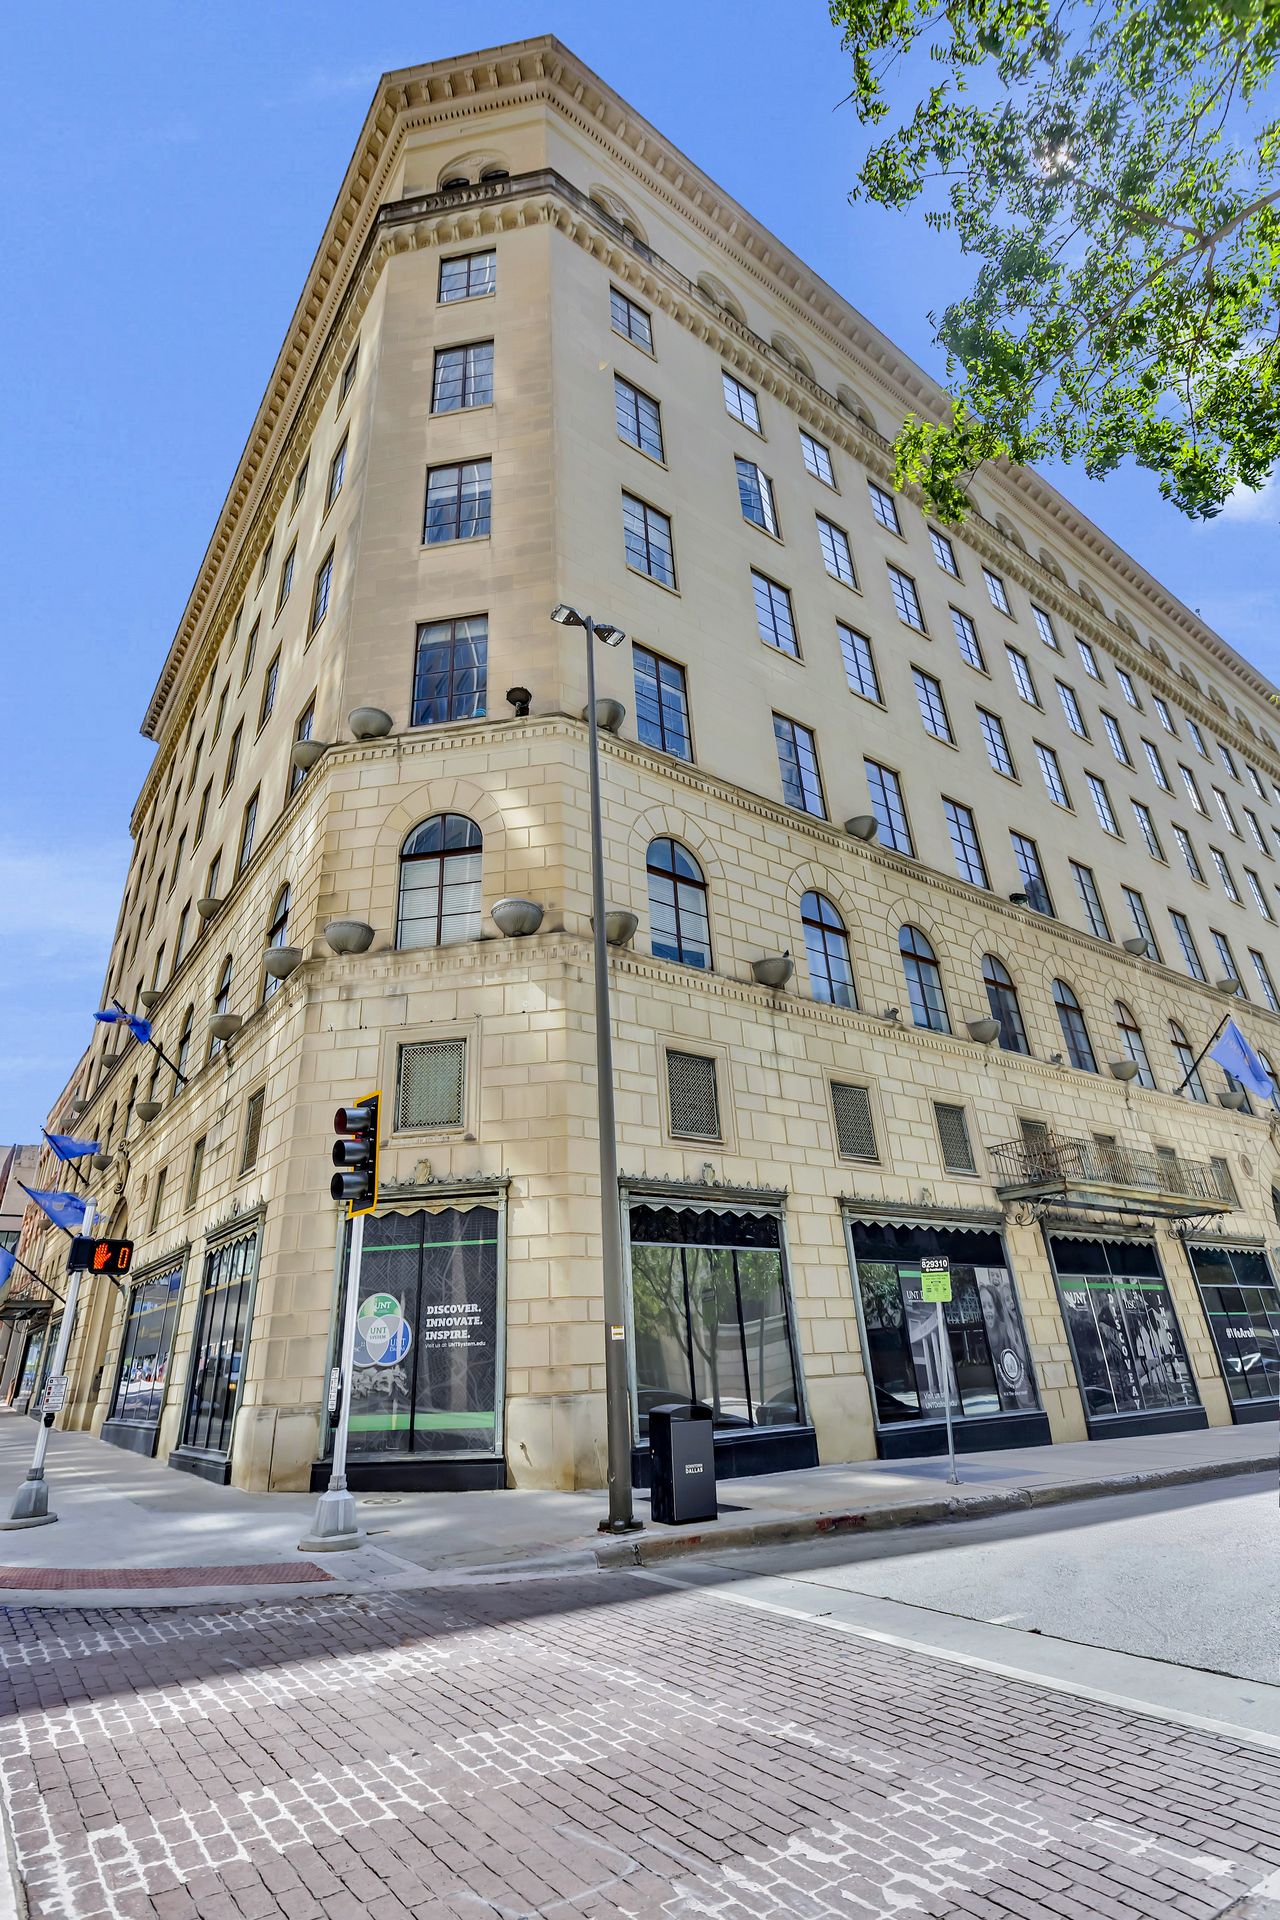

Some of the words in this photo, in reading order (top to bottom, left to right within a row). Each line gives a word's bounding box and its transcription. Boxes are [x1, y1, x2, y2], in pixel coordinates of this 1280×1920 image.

[117, 1247, 129, 1269] 0
[921, 1259, 948, 1269] 829310
[906, 1290, 919, 1300] UNT
[374, 1301, 392, 1310] UNT
[426, 1303, 482, 1315] DISCOVER.
[426, 1316, 483, 1328] INNOVATE.
[370, 1327, 388, 1335] UNT
[425, 1329, 471, 1341] INSPIRE.
